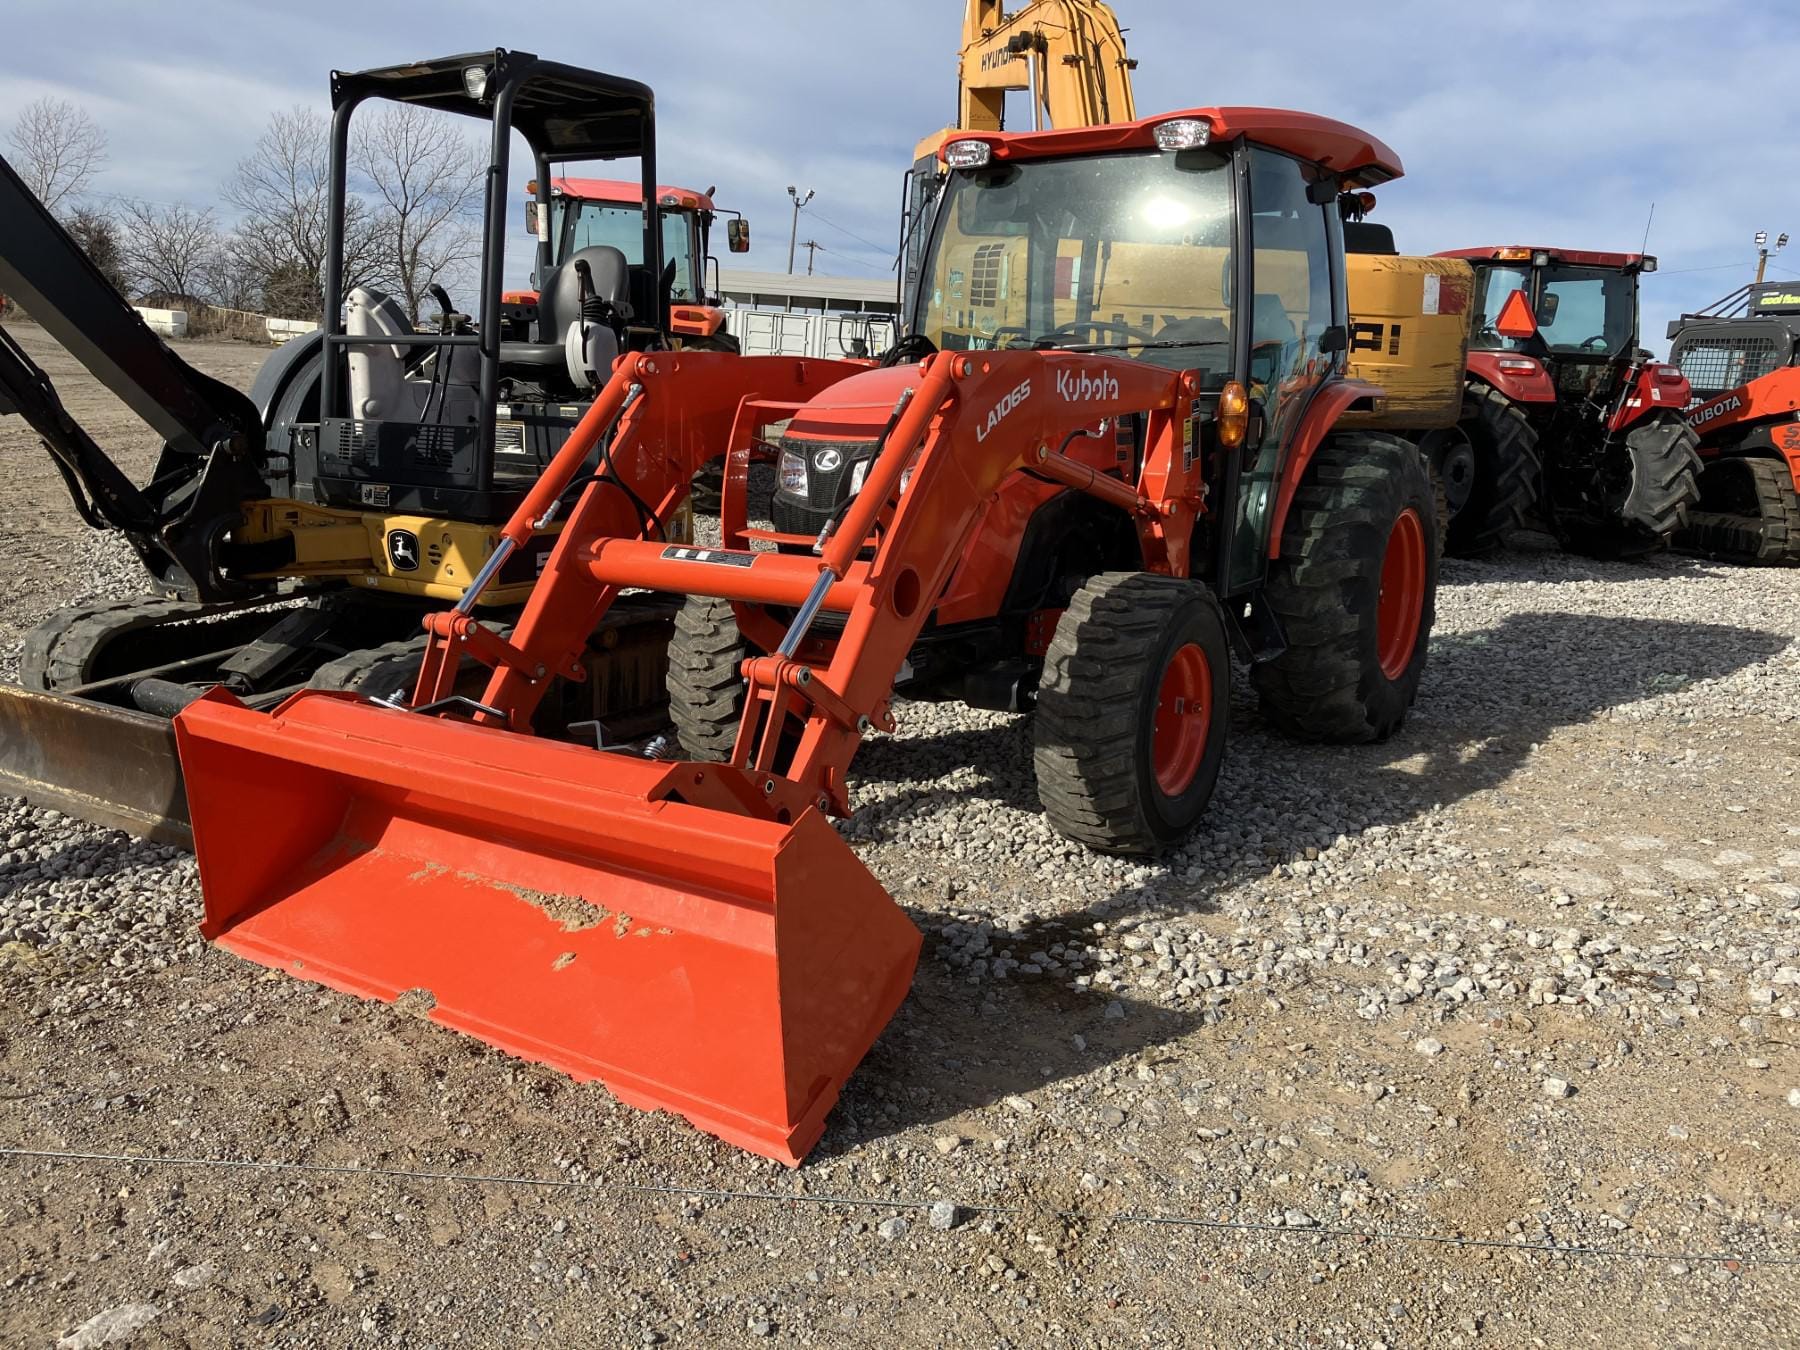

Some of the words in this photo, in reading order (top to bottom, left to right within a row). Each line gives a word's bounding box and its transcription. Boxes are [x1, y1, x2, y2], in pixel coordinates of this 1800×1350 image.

[1056, 369, 1119, 401] Kubota
[976, 378, 1031, 442] LA1065
[1685, 396, 1741, 430] KUBOTA
